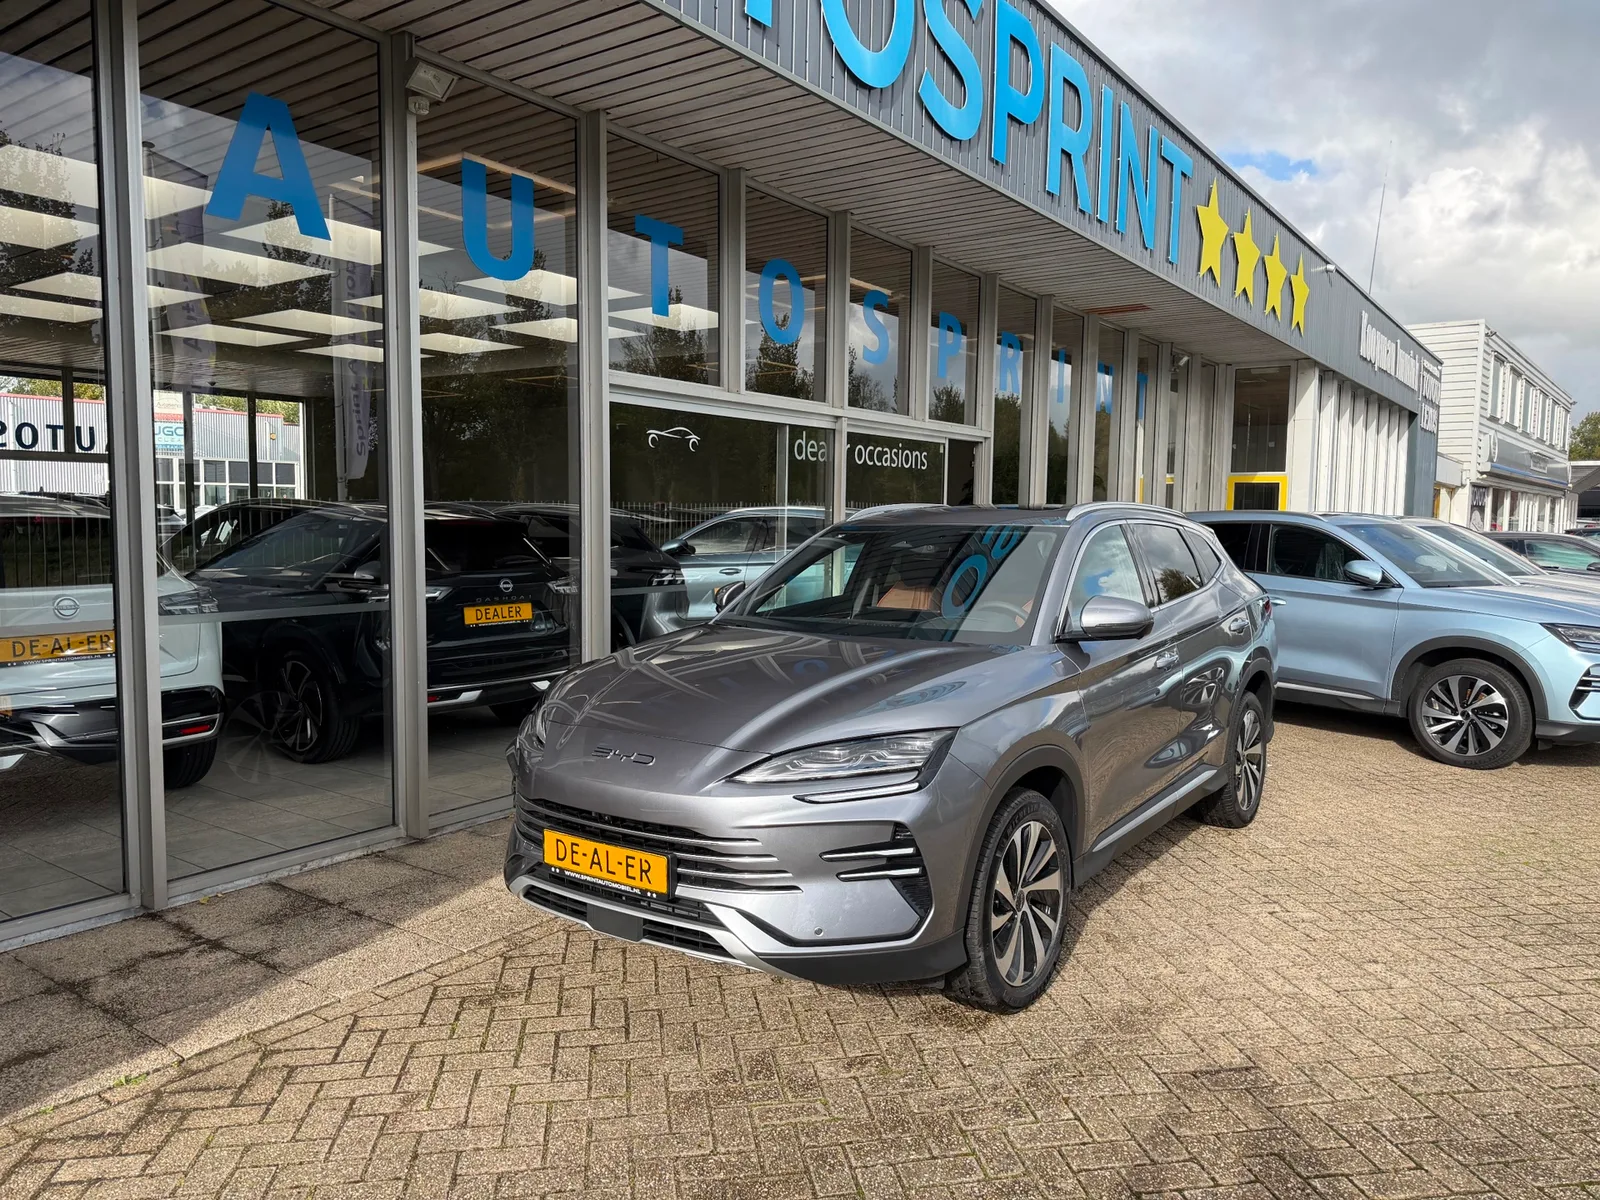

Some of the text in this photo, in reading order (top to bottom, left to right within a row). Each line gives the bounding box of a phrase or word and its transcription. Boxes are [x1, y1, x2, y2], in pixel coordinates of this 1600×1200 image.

[745, 0, 1193, 263] OSPRINT
[794, 431, 928, 470] dear occasions
[475, 605, 522, 621] DEALER
[591, 746, 656, 767] BYD
[555, 838, 653, 885] DE-AL-ER
